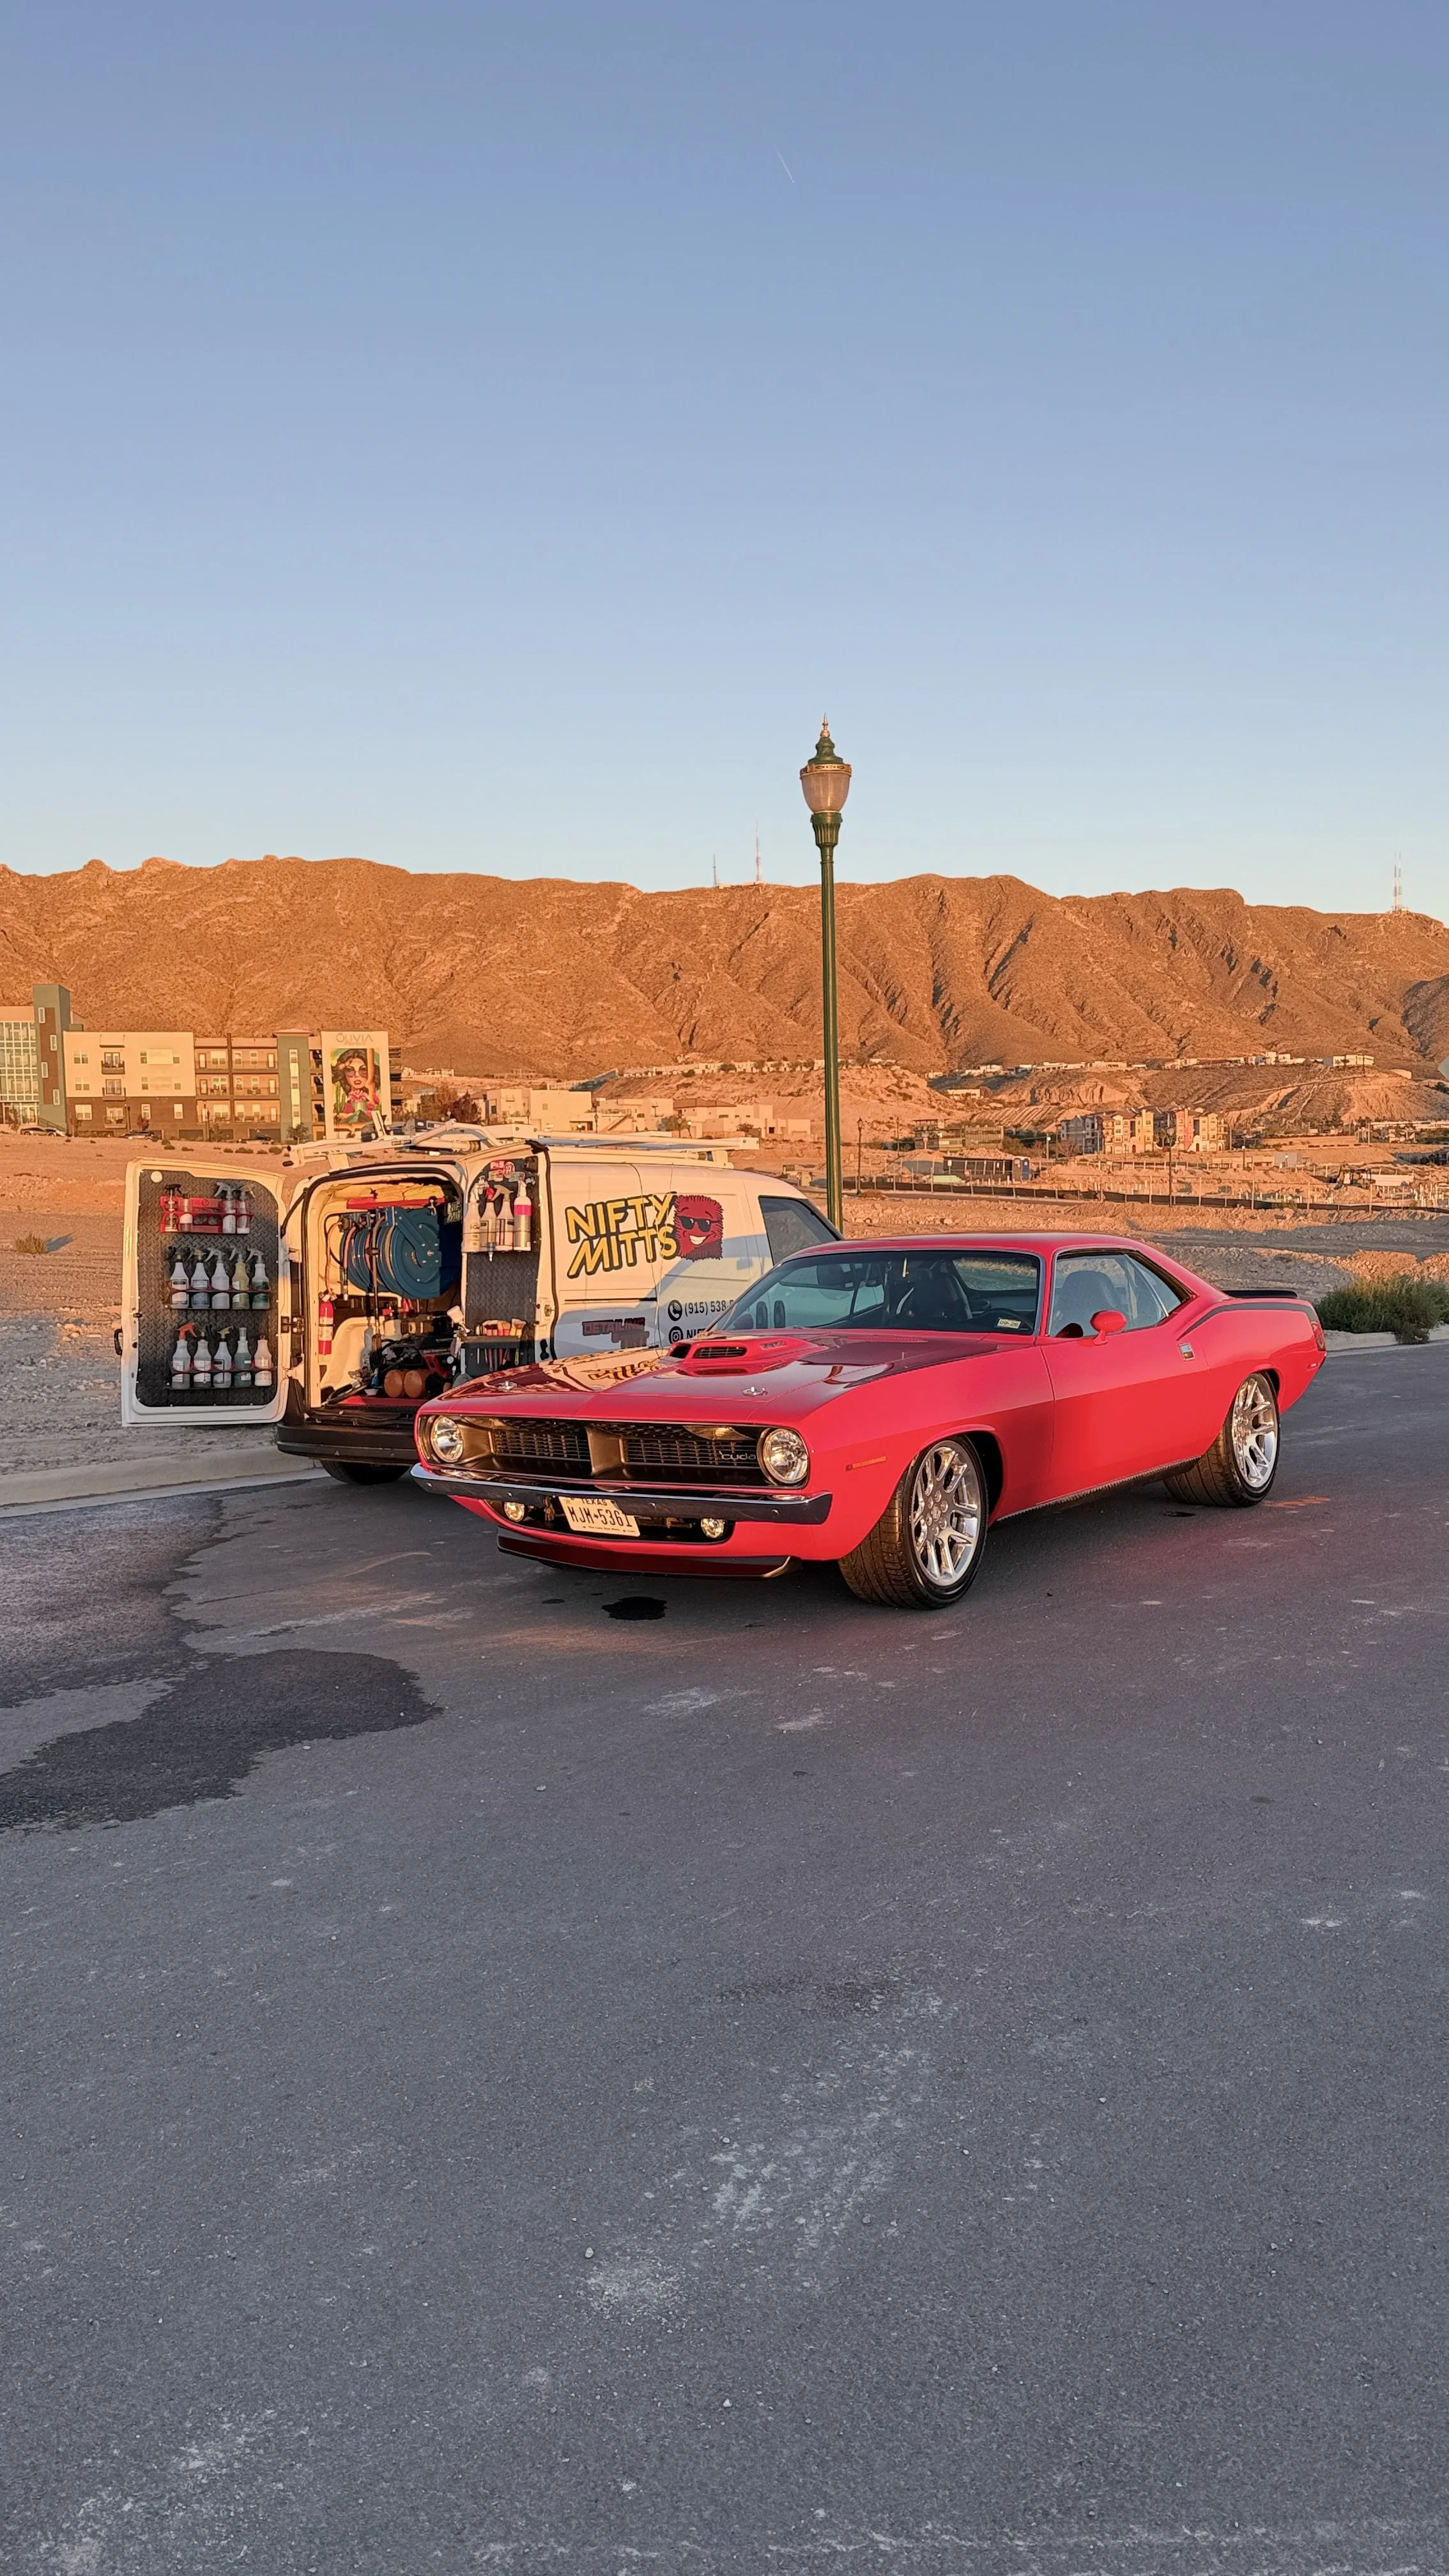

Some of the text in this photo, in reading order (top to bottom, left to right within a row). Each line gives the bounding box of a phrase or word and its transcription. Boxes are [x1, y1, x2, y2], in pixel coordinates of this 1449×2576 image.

[565, 1192, 677, 1243] NIFTY
[567, 1224, 679, 1279] MITTS
[685, 1301, 708, 1317] (915)
[582, 1498, 608, 1506] TEXAS
